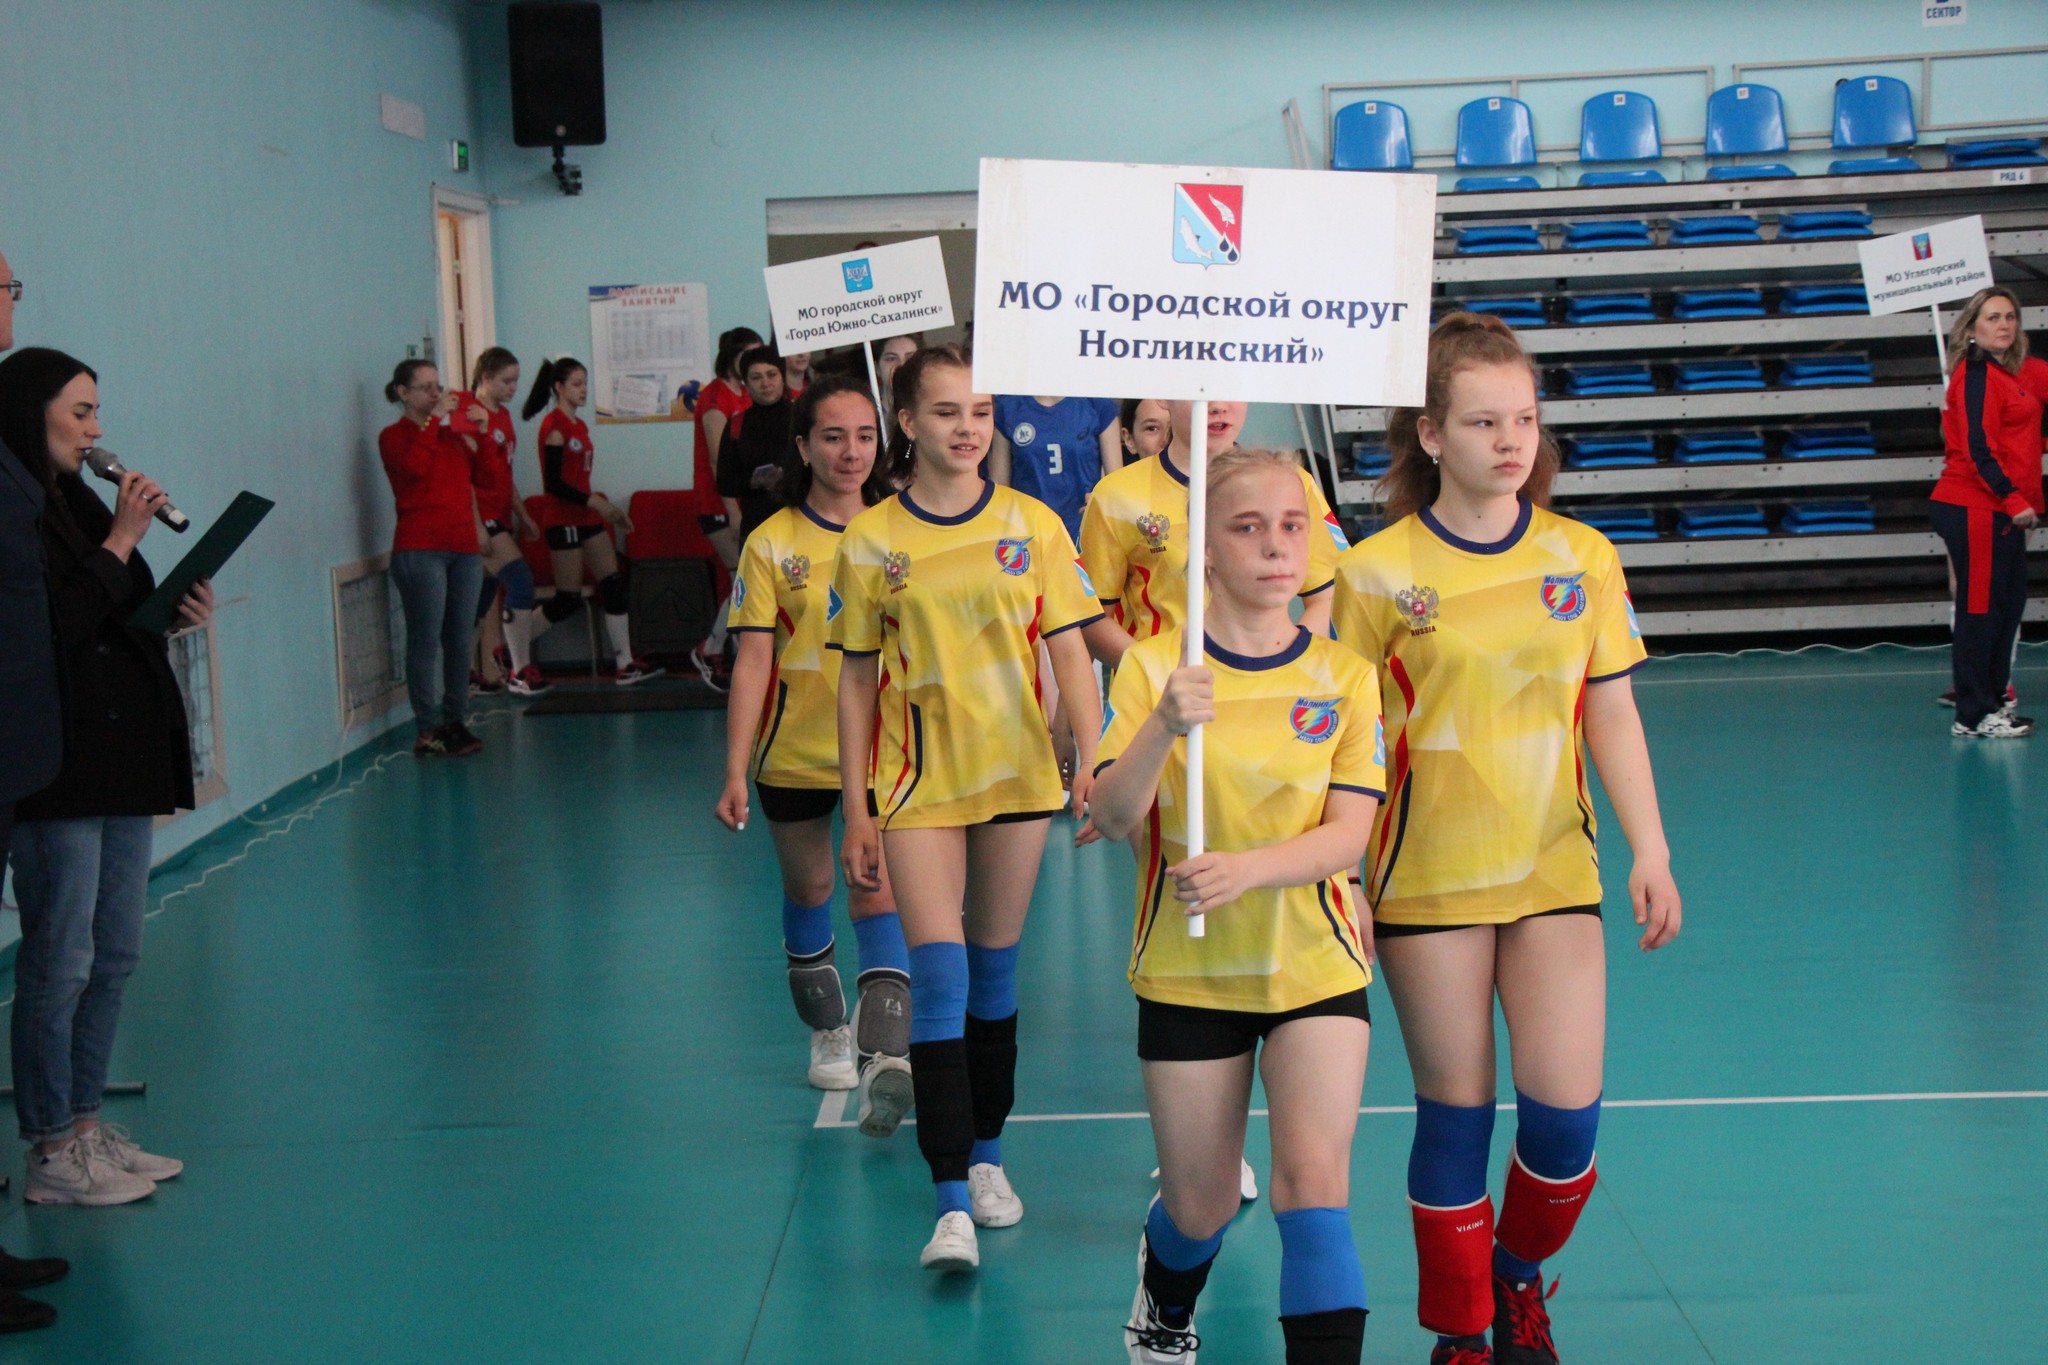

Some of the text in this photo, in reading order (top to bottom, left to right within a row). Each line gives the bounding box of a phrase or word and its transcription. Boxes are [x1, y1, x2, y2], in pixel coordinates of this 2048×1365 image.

[1926, 5, 1962, 19] СЕКТОР
[2000, 171, 2017, 181] РЯД
[1885, 260, 1966, 284] МО Углегорский
[1873, 270, 1986, 301] муниципальный район
[621, 296, 677, 307] ЗАНЯТИЙ
[797, 289, 924, 321] МО городской округ
[998, 280, 1409, 329] МО «Городской округ
[784, 305, 943, 342] «Город Южно-Сахалинск»
[1077, 328, 1324, 364] Ногликский»
[1046, 443, 1063, 475] 3
[565, 526, 579, 543] 11
[1544, 575, 1574, 584] Молния
[1410, 625, 1437, 637] RUSSIA
[1297, 698, 1329, 708] Молния
[1456, 1219, 1484, 1233] VIKING
